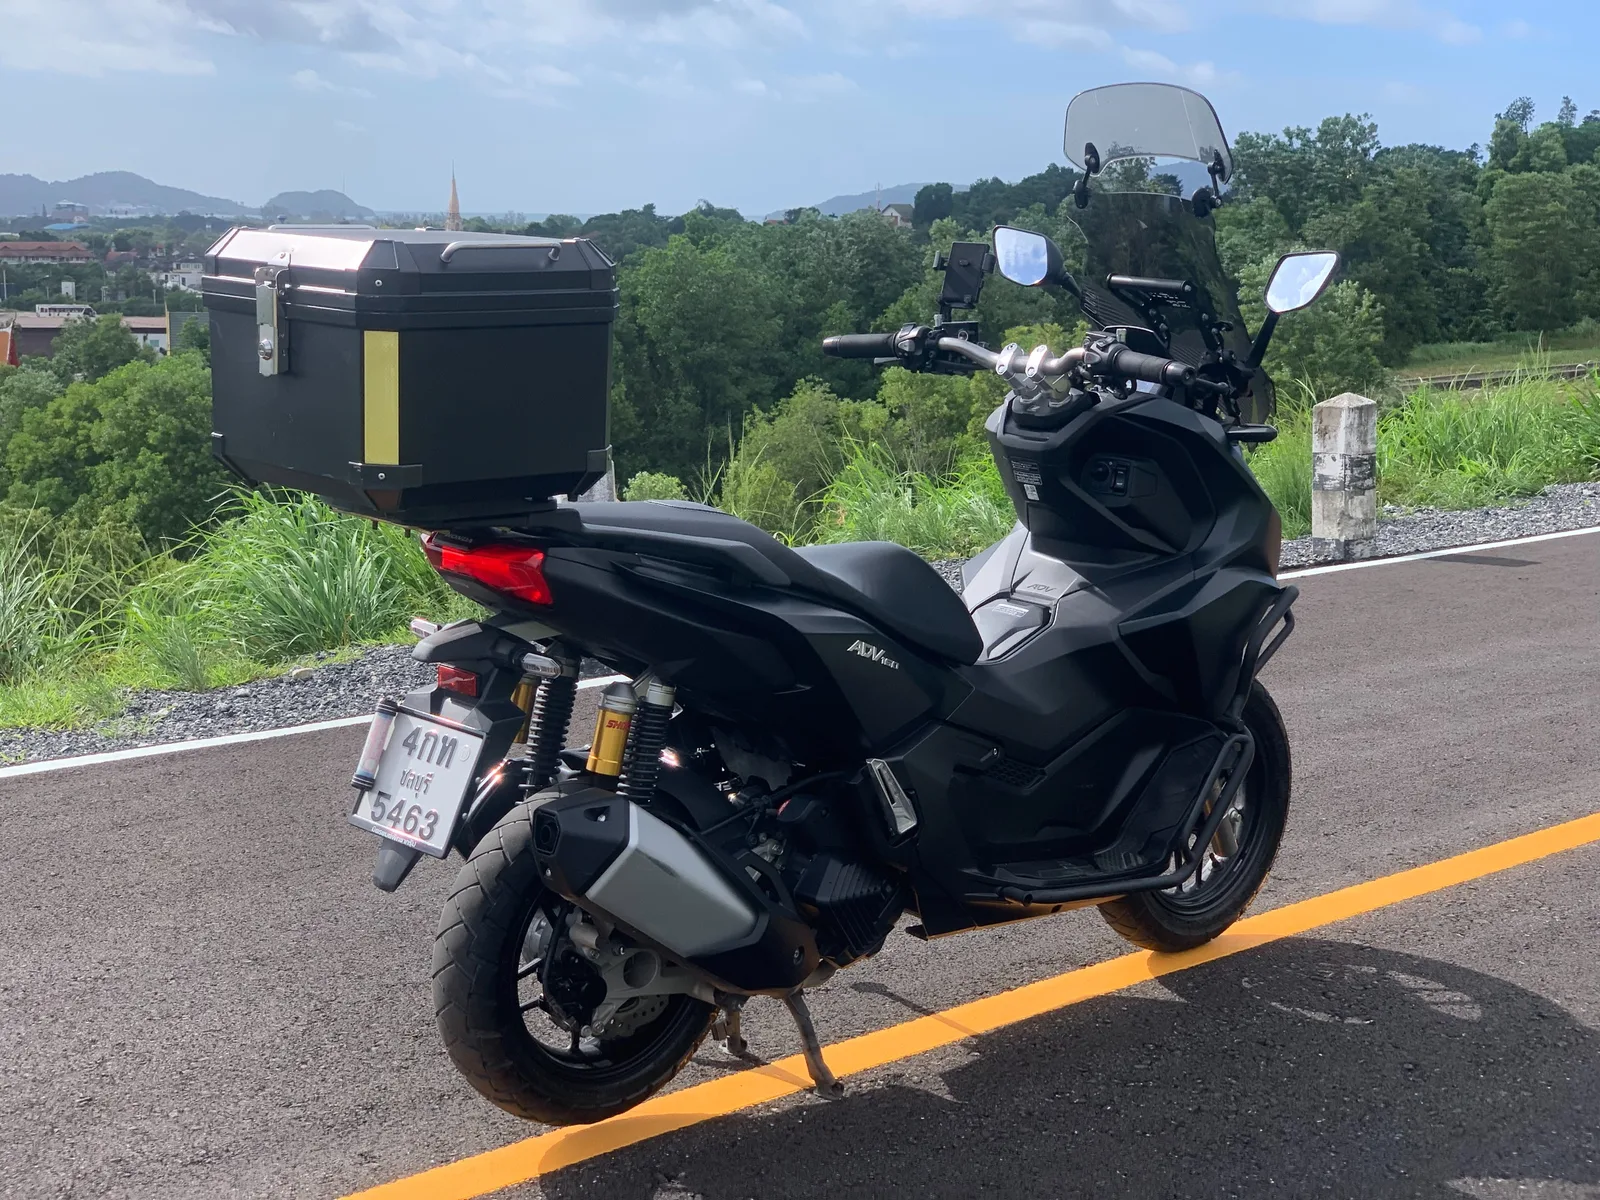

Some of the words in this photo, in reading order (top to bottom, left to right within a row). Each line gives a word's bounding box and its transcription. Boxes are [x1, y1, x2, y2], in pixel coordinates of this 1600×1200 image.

[1027, 583, 1056, 592] ADV
[402, 725, 458, 769] 4กท
[400, 769, 434, 798] ชลบุรี
[371, 791, 440, 840] 5463
